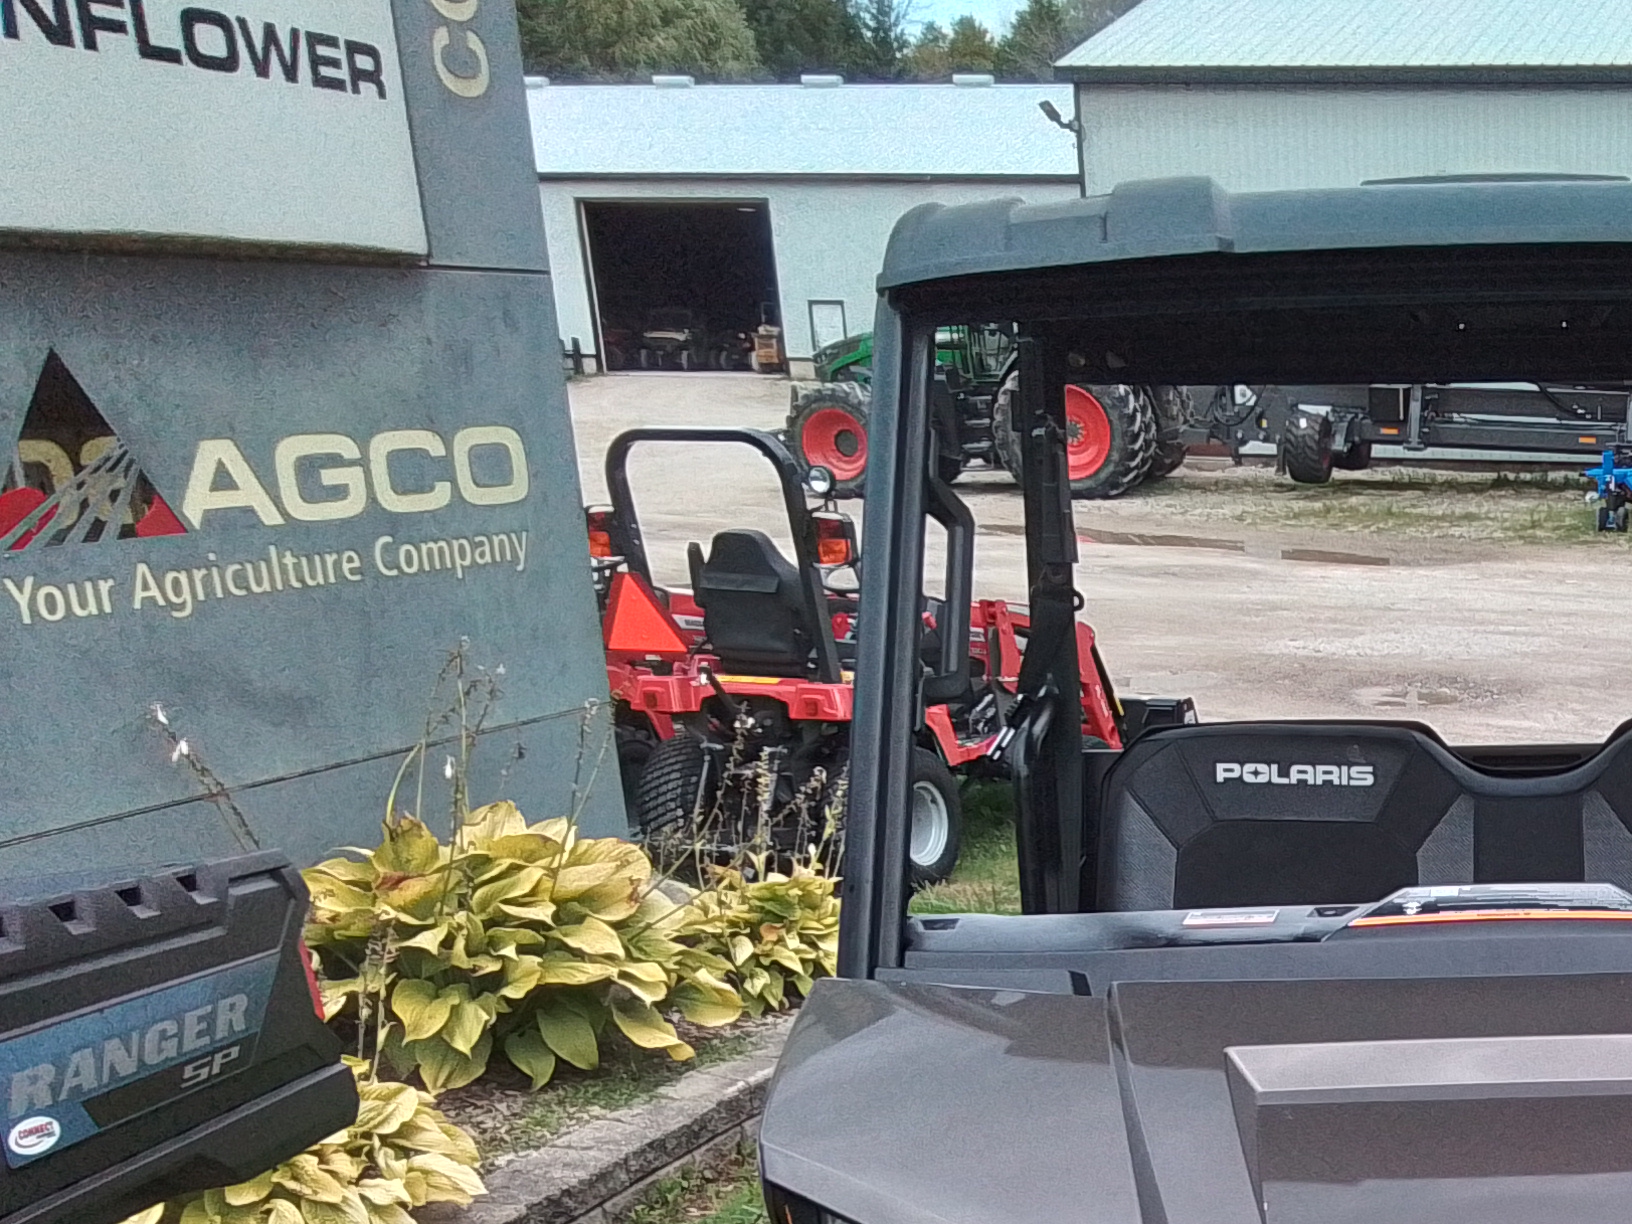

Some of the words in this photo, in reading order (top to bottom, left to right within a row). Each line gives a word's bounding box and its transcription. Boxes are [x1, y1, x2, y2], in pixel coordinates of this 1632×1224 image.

[183, 426, 530, 530] AGCO
[3, 577, 114, 624] Your
[133, 545, 362, 618] Agriculture
[374, 530, 529, 580] Company
[1215, 762, 1375, 786] POLARIS
[8, 993, 249, 1117] RANGER
